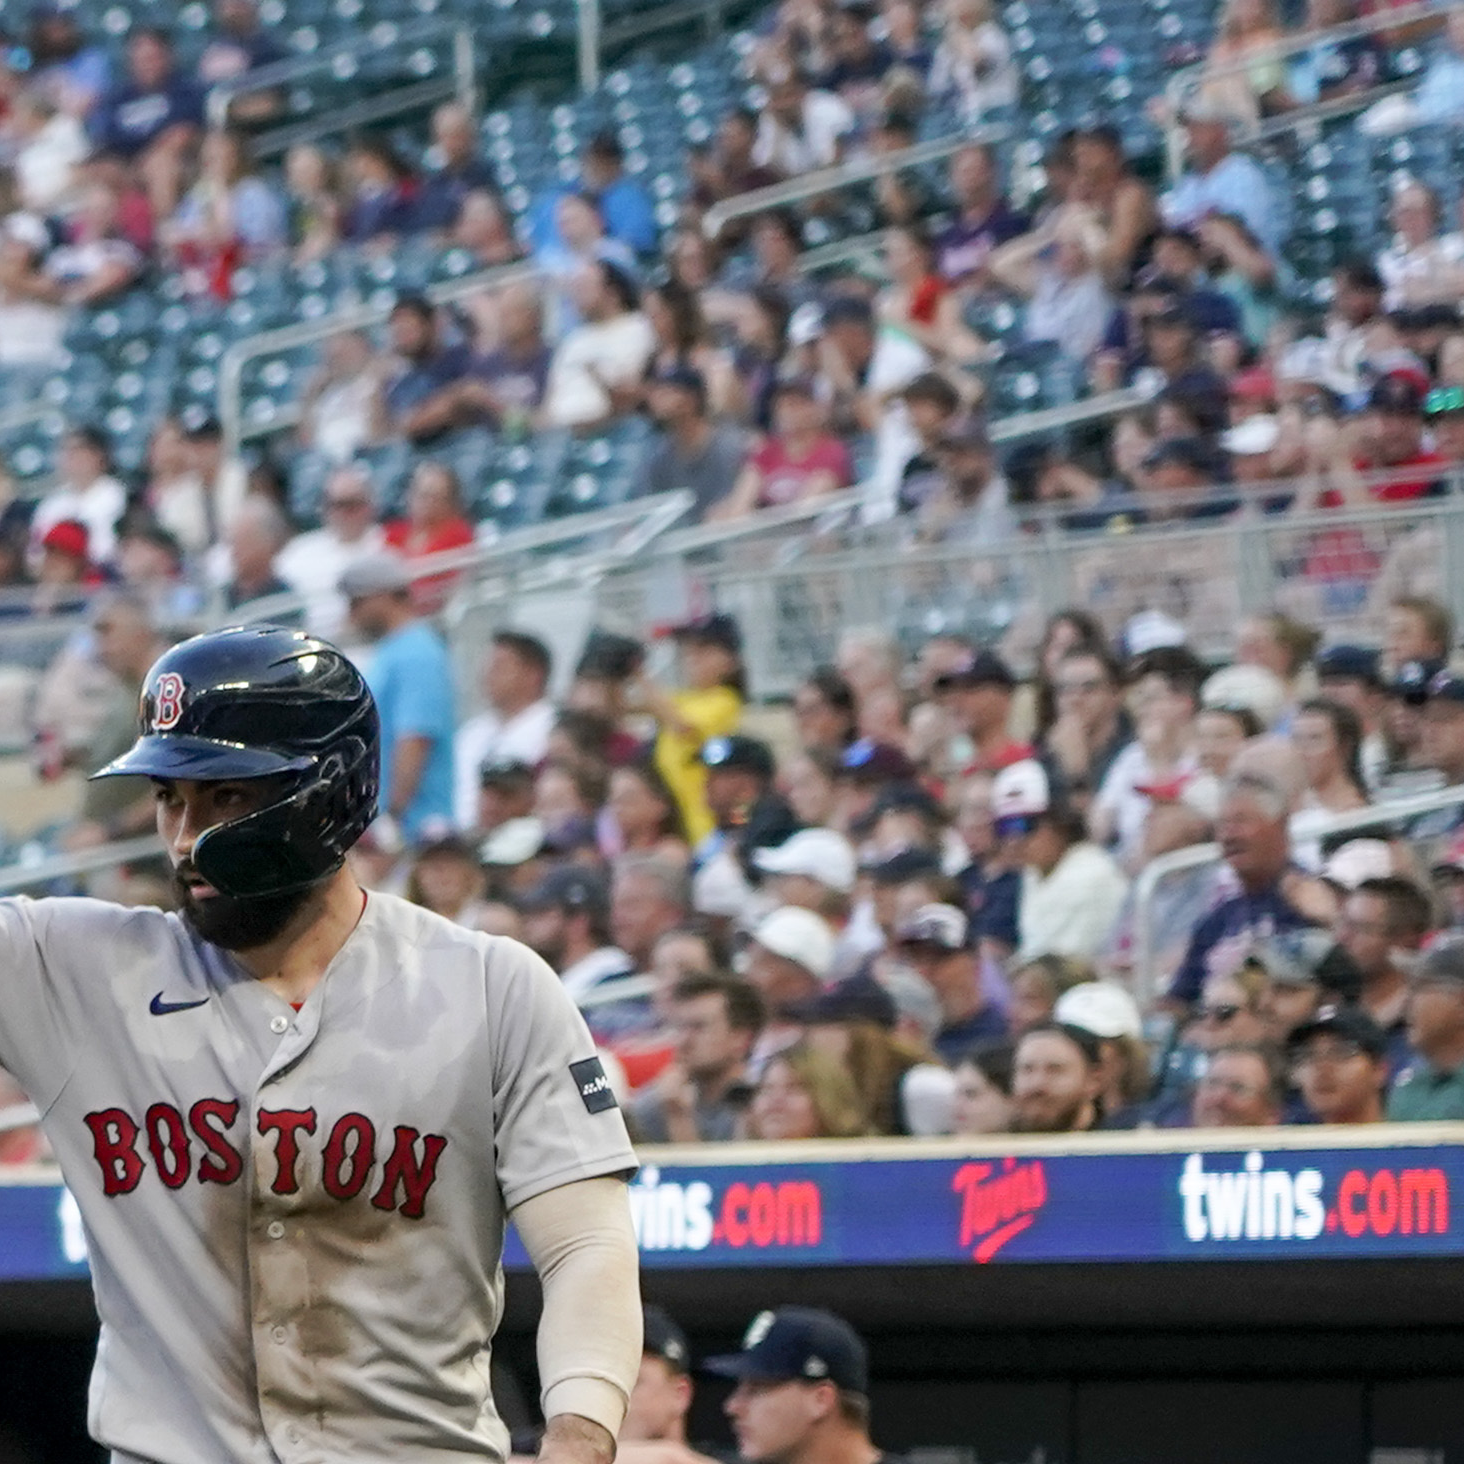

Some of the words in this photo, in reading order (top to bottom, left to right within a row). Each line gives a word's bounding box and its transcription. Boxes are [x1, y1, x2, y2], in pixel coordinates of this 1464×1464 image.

[151, 672, 186, 730] B
[83, 1098, 448, 1219] BOSTON
[1179, 1150, 1450, 1242] twins.com
